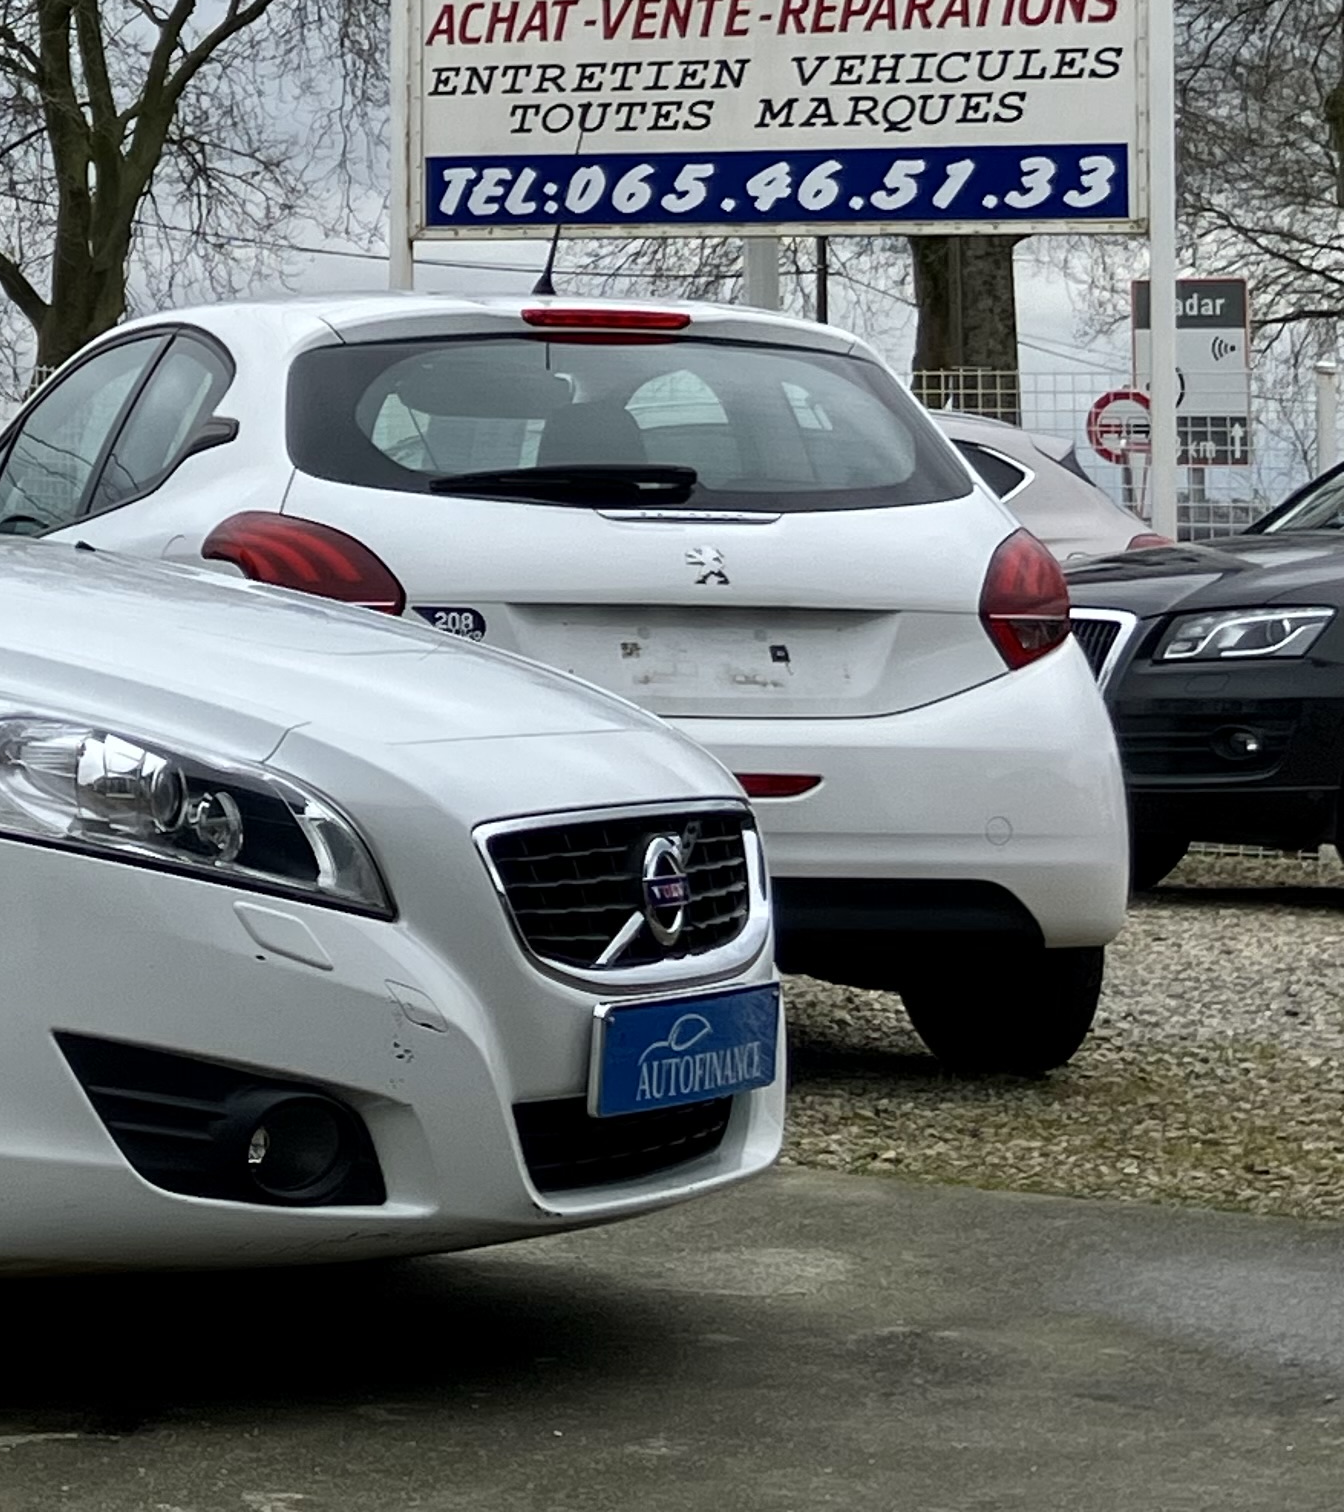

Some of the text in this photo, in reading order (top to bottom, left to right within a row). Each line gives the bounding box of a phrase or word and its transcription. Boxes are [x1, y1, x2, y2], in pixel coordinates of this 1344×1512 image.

[427, 46, 1124, 97] ENTRETIEN VEHICULES
[509, 91, 1027, 135] TOUTES MARQUES
[1175, 291, 1226, 317] adar
[433, 610, 474, 630] 208
[635, 1040, 762, 1102] AUTOFINANCE
